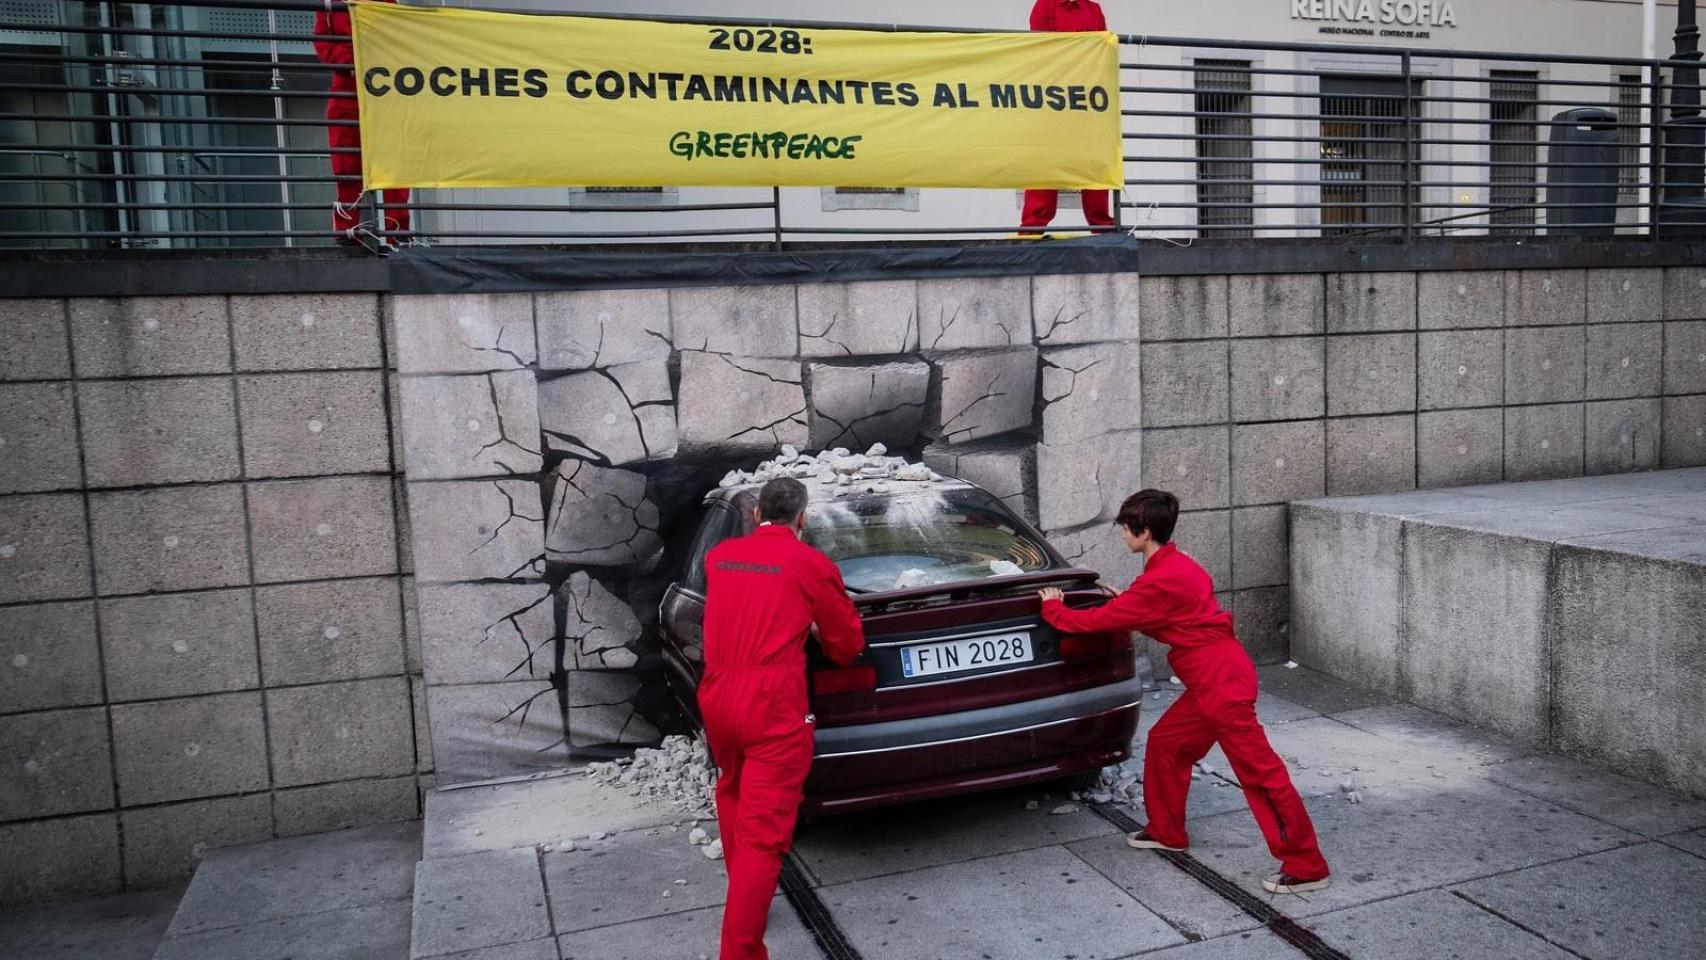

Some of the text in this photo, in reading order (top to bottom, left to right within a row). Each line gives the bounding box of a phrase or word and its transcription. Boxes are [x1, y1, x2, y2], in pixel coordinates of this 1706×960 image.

[1290, 0, 1376, 23] REINA
[708, 28, 813, 55] 2028:
[364, 66, 1109, 113] COCHES CONTAMINANTES AL MUSEO
[669, 131, 862, 162] GREENPEACE
[917, 637, 1025, 671] FIN 2028
